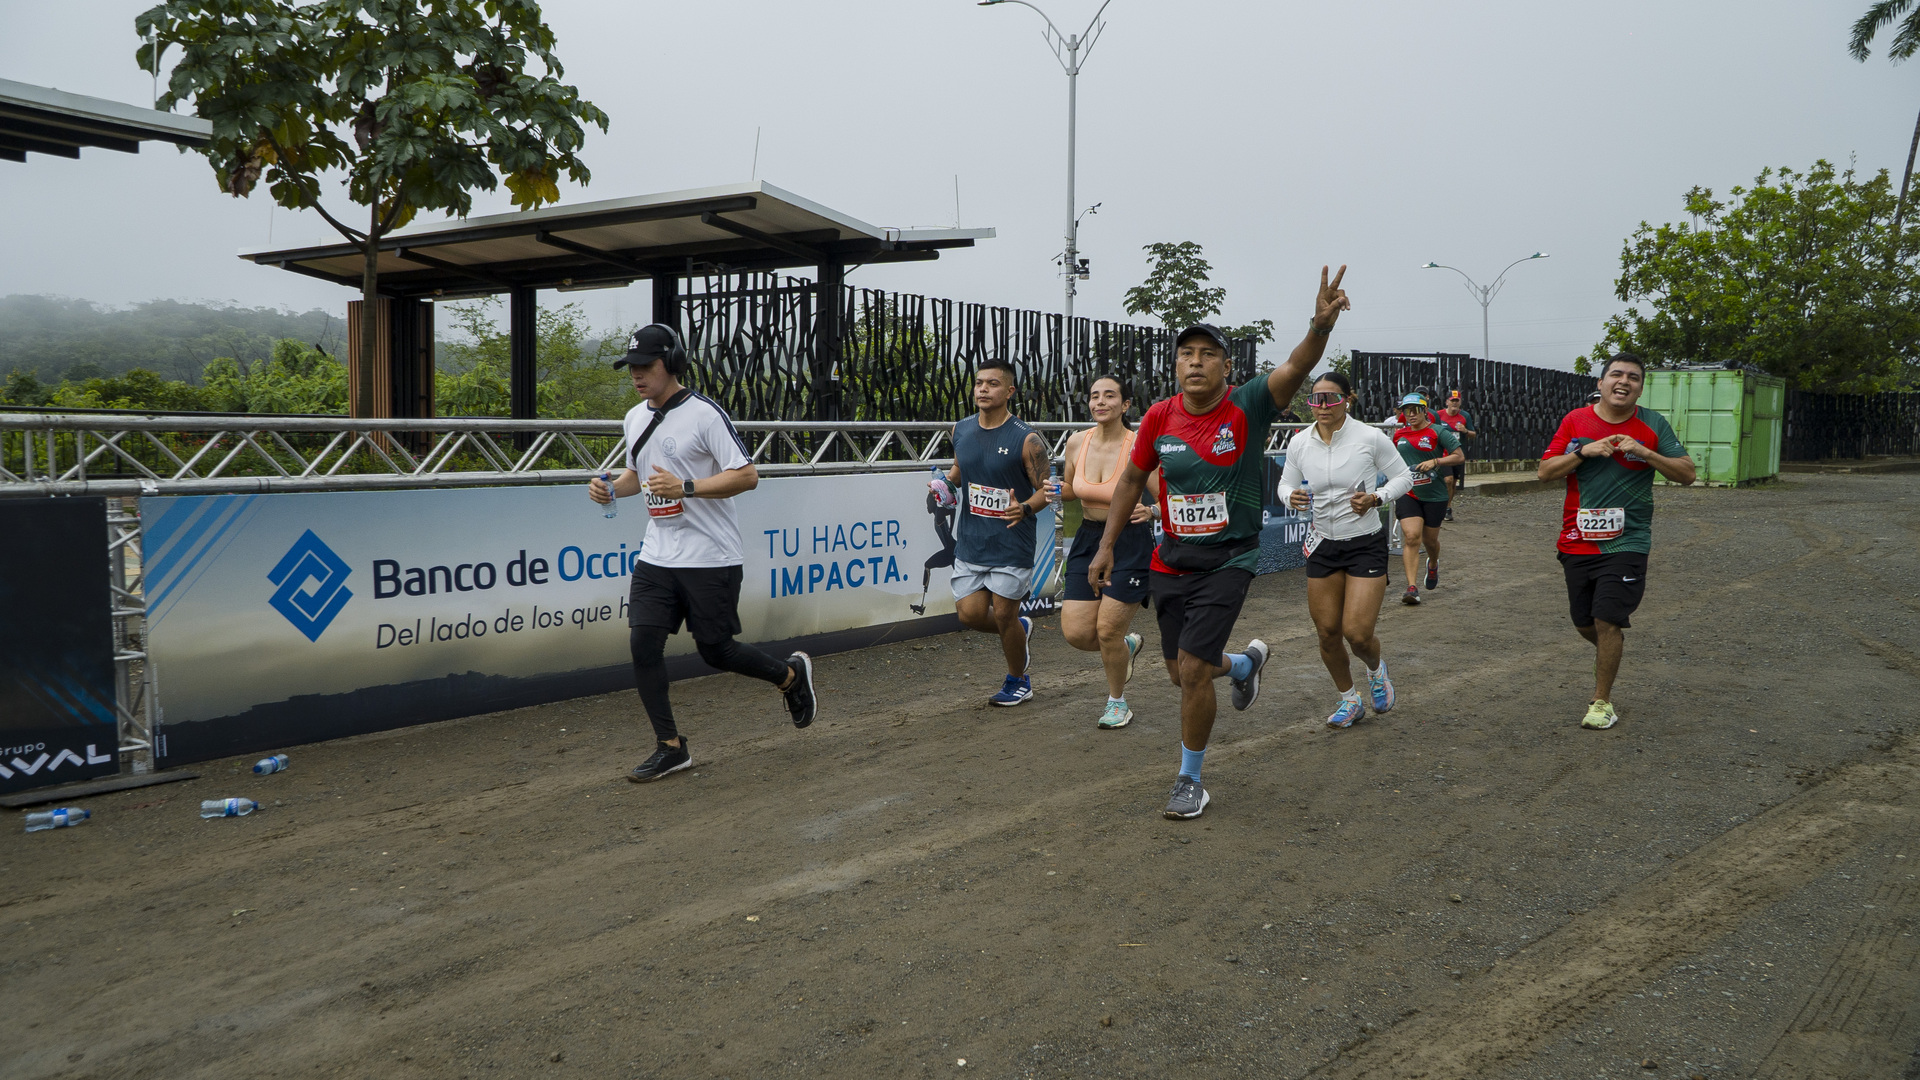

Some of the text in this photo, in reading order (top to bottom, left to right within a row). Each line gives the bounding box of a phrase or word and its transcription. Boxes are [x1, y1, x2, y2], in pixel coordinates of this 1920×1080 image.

[973, 494, 1000, 509] 1701
[1178, 505, 1217, 523] 1874
[764, 519, 907, 558] TU HACER,
[1583, 518, 1615, 530] 2221
[372, 558, 497, 600] Banco
[506, 549, 549, 587] de
[770, 555, 909, 599] IMPACTA.
[376, 618, 421, 649] Del
[430, 613, 487, 643] lado
[494, 608, 524, 634] de
[532, 605, 564, 630] los
[571, 604, 612, 630] que
